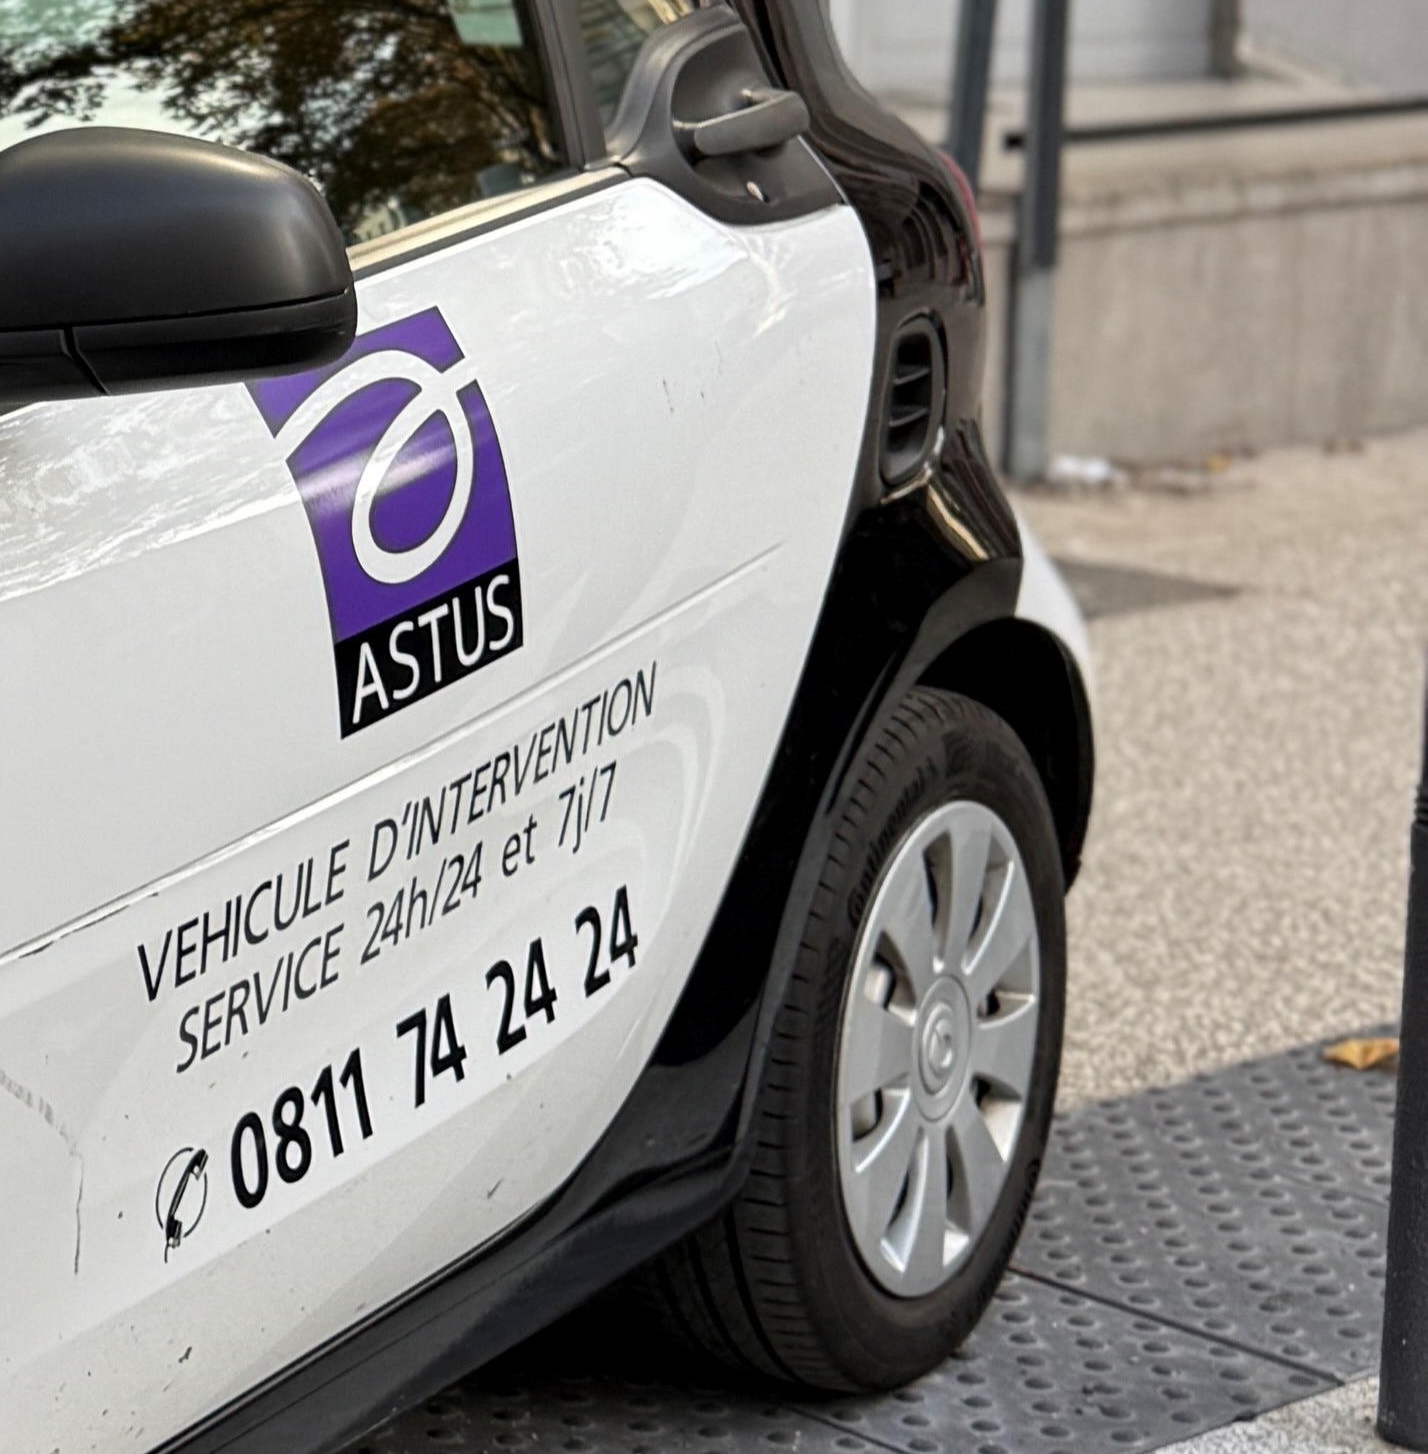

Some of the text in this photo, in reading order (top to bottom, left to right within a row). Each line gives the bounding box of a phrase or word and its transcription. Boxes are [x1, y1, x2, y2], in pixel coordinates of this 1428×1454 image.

[351, 573, 517, 724] ASTUS
[137, 661, 658, 1003] VEHICULE D'INTERVENTION
[174, 761, 619, 1075] SERVICE 24h/24 et 7j/7
[228, 884, 641, 1210] 0811 74 24 24
